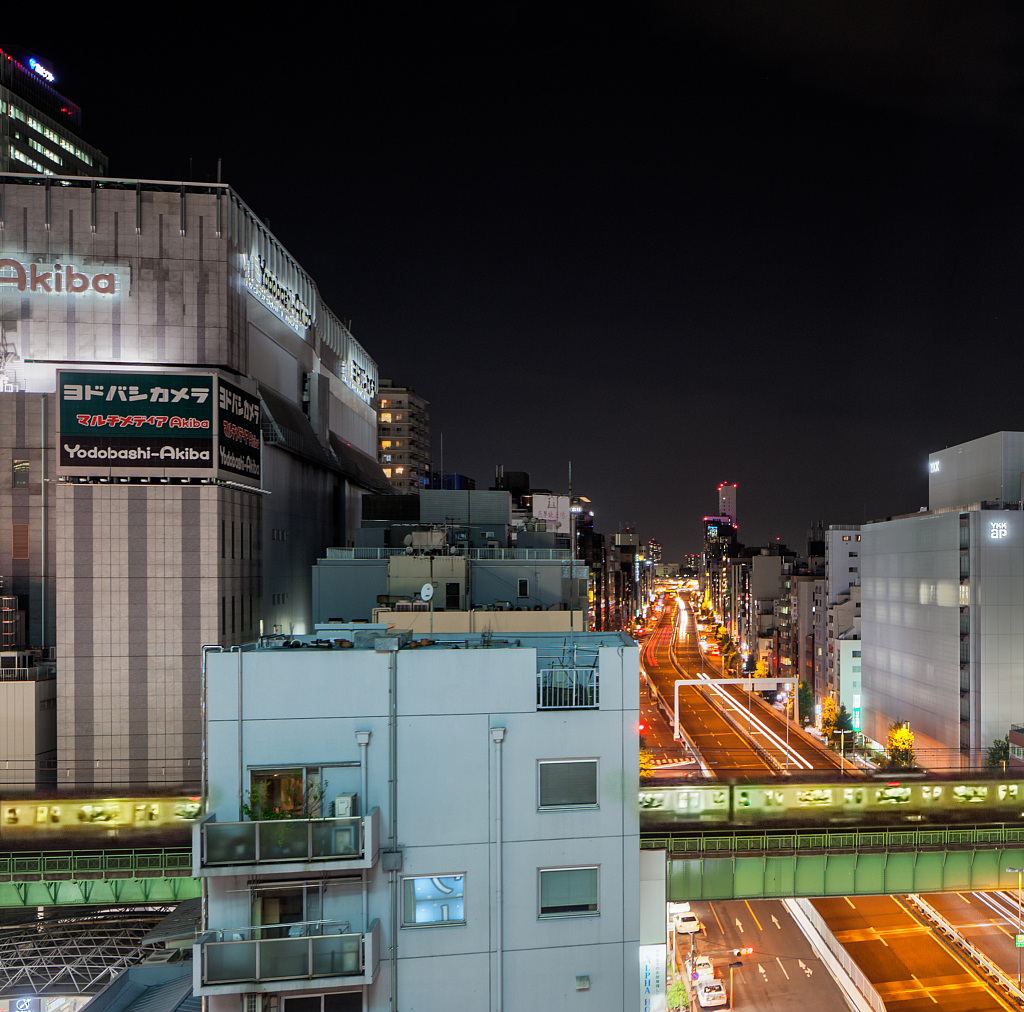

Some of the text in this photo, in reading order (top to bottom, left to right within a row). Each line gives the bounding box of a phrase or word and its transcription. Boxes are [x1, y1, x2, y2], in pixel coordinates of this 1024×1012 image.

[0, 259, 115, 294] Akiba
[63, 384, 210, 404] ヨドバシカメラ
[219, 386, 260, 425] ヨドバシカメラ
[63, 443, 210, 461] Yodobashi-Akiba
[219, 445, 260, 476] Yodobashi-Akiba
[990, 522, 1008, 530] YKK
[990, 529, 1008, 539] ap
[643, 955, 652, 995] ALPHA
